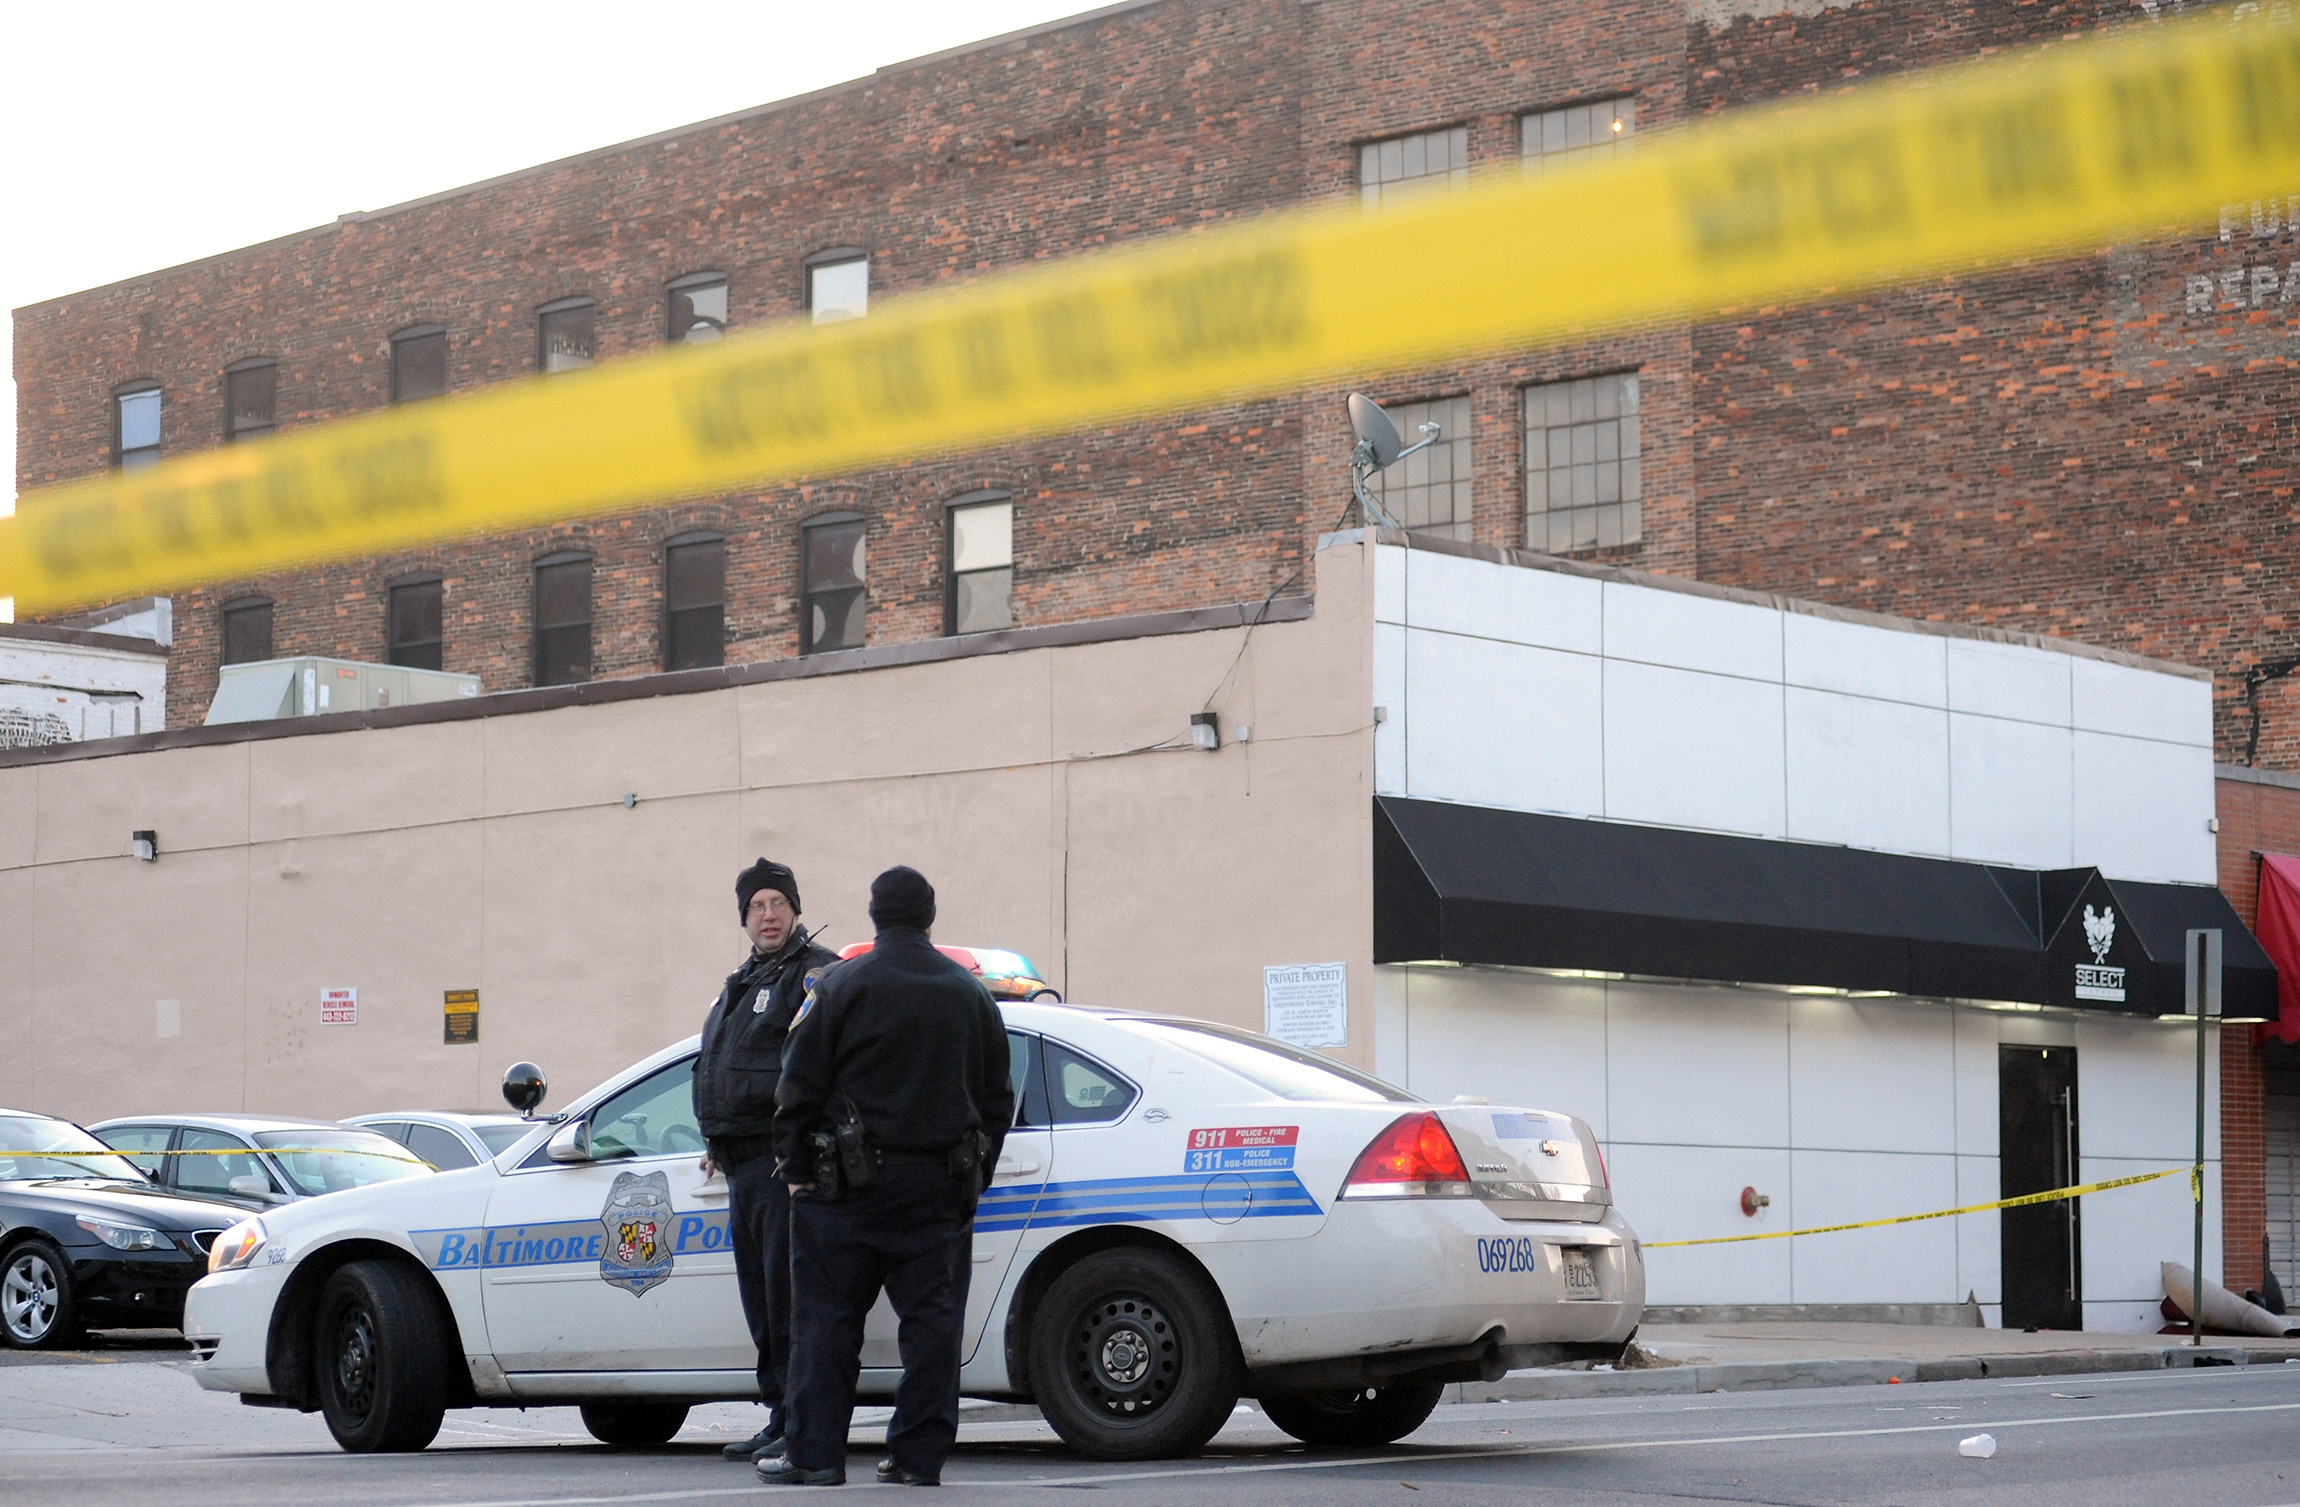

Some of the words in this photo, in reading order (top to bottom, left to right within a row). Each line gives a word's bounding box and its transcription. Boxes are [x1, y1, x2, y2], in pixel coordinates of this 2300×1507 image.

[1269, 971, 1300, 984] PRIVATE
[1302, 969, 1341, 982] PROPERTY
[2075, 969, 2125, 988] SELECT
[1195, 1130, 1227, 1148] 911
[1236, 1129, 1262, 1137] POLICE
[1269, 1128, 1287, 1136] FIRE
[1242, 1137, 1276, 1145] MEDICAL
[1191, 1151, 1222, 1171] 311
[1244, 1150, 1271, 1158] POLICE
[1224, 1158, 1288, 1168] NON-EMERGENCY
[618, 1209, 657, 1220] POLICE
[267, 1247, 286, 1264] 9268
[1477, 1237, 1535, 1273] 069268
